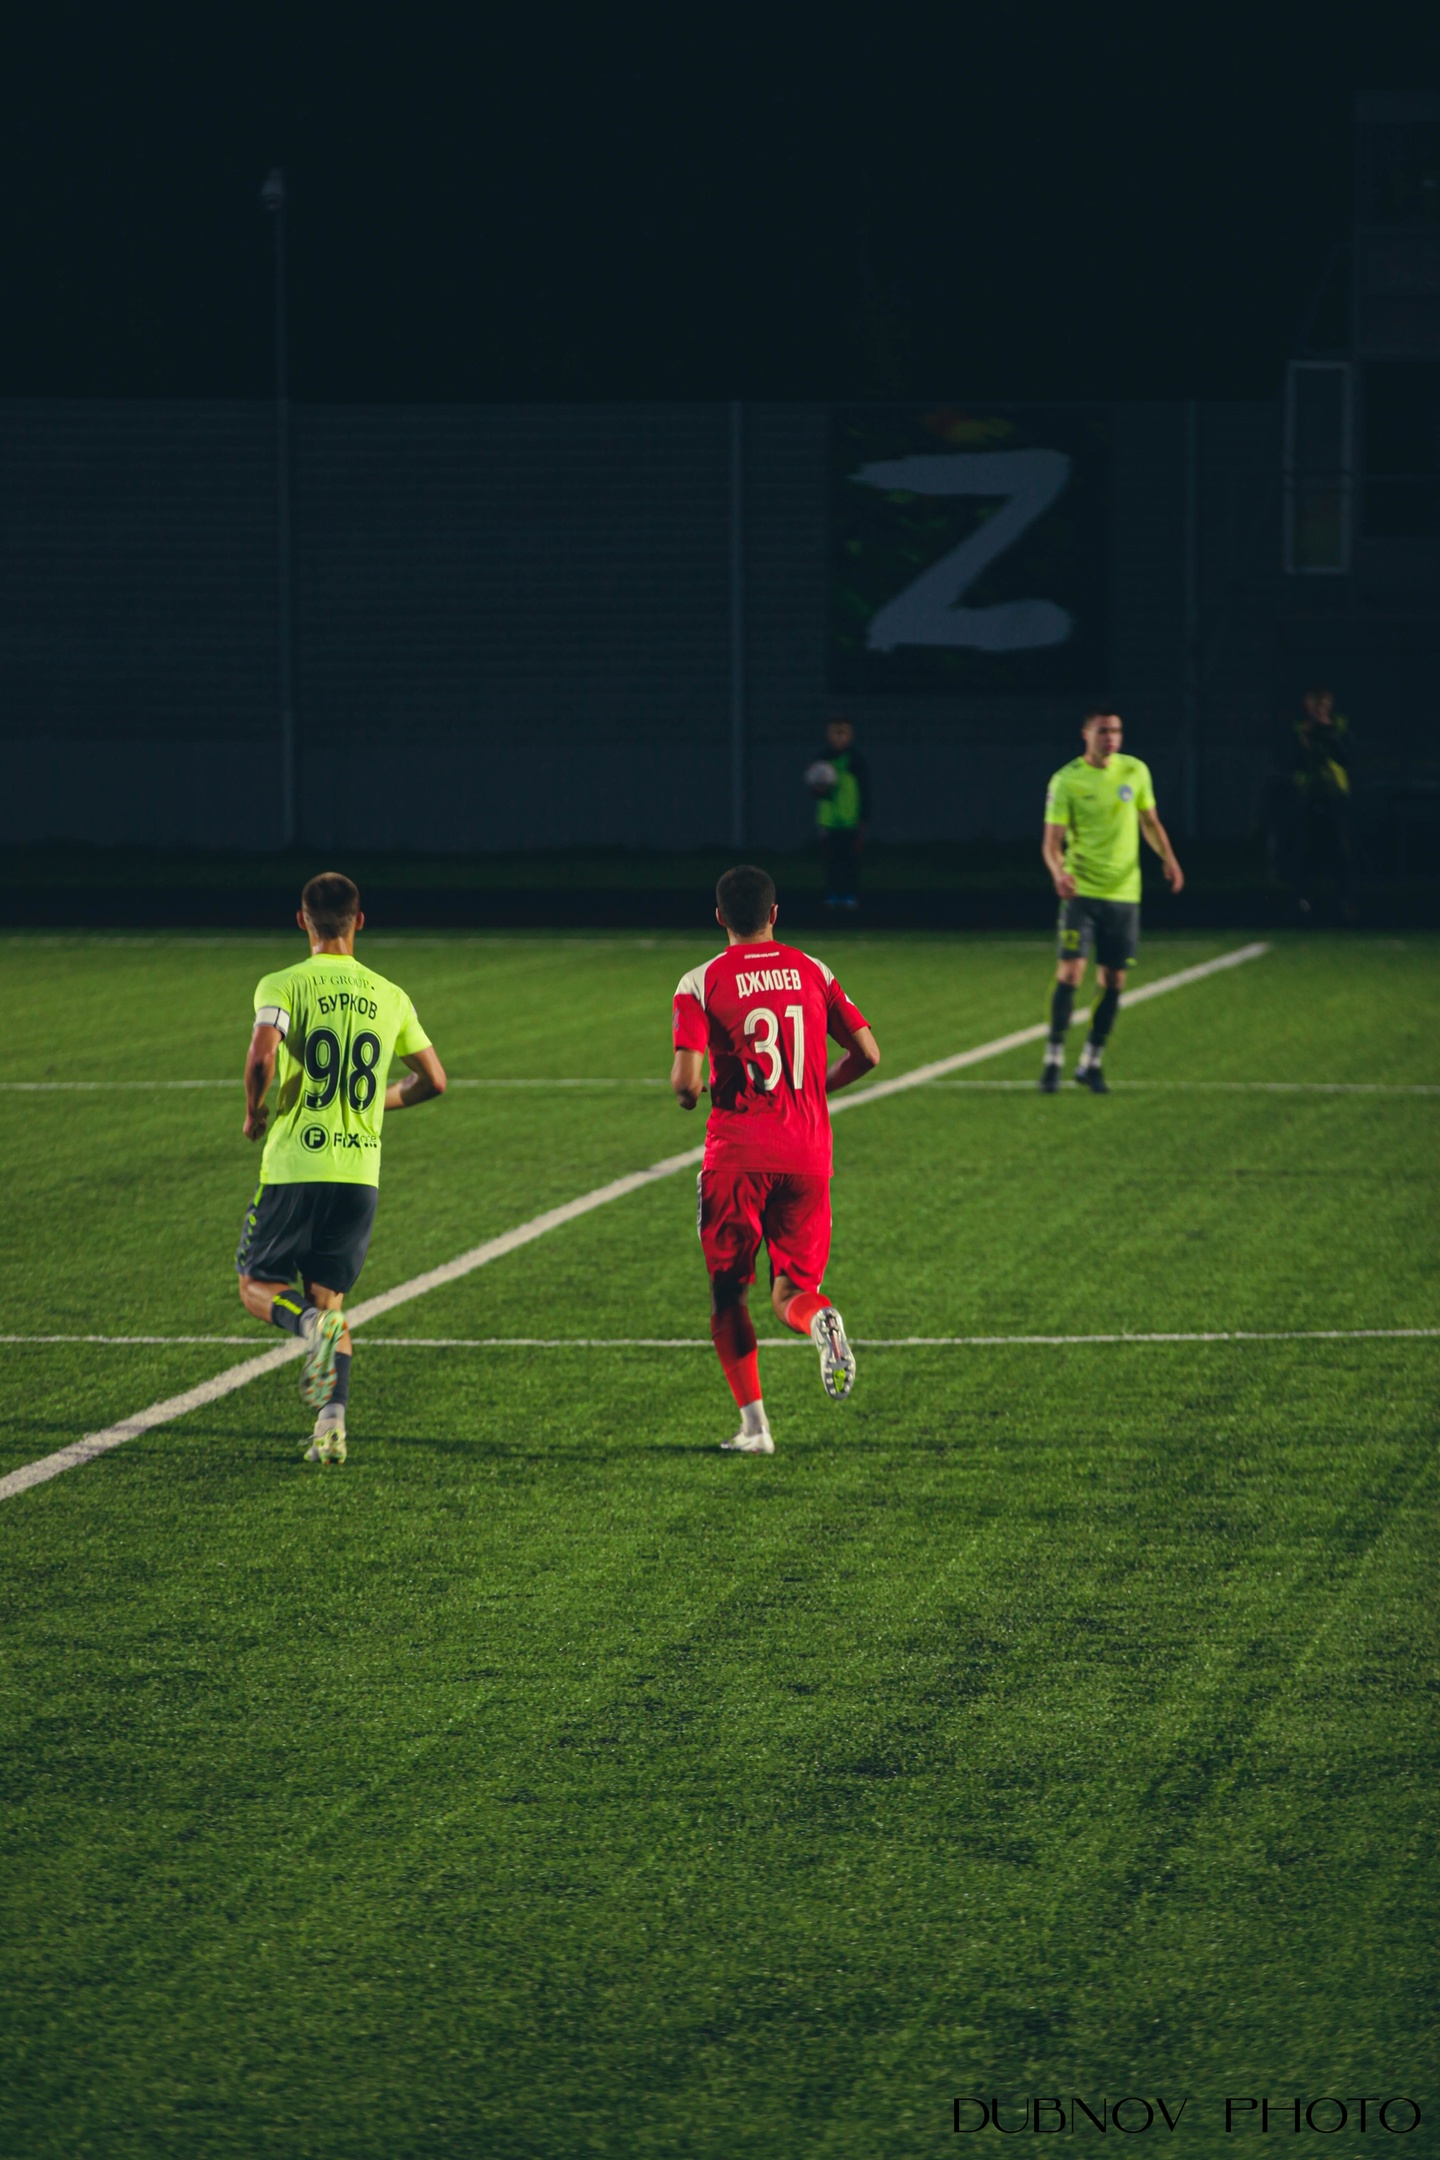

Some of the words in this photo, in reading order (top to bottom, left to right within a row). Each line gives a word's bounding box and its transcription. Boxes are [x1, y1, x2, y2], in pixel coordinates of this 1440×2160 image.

[849, 448, 1074, 653] Z
[318, 993, 378, 1019] БУРКОВ
[735, 969, 802, 998] ДЖИОЕВ
[303, 1026, 382, 1114] 98
[744, 1005, 805, 1091] 31
